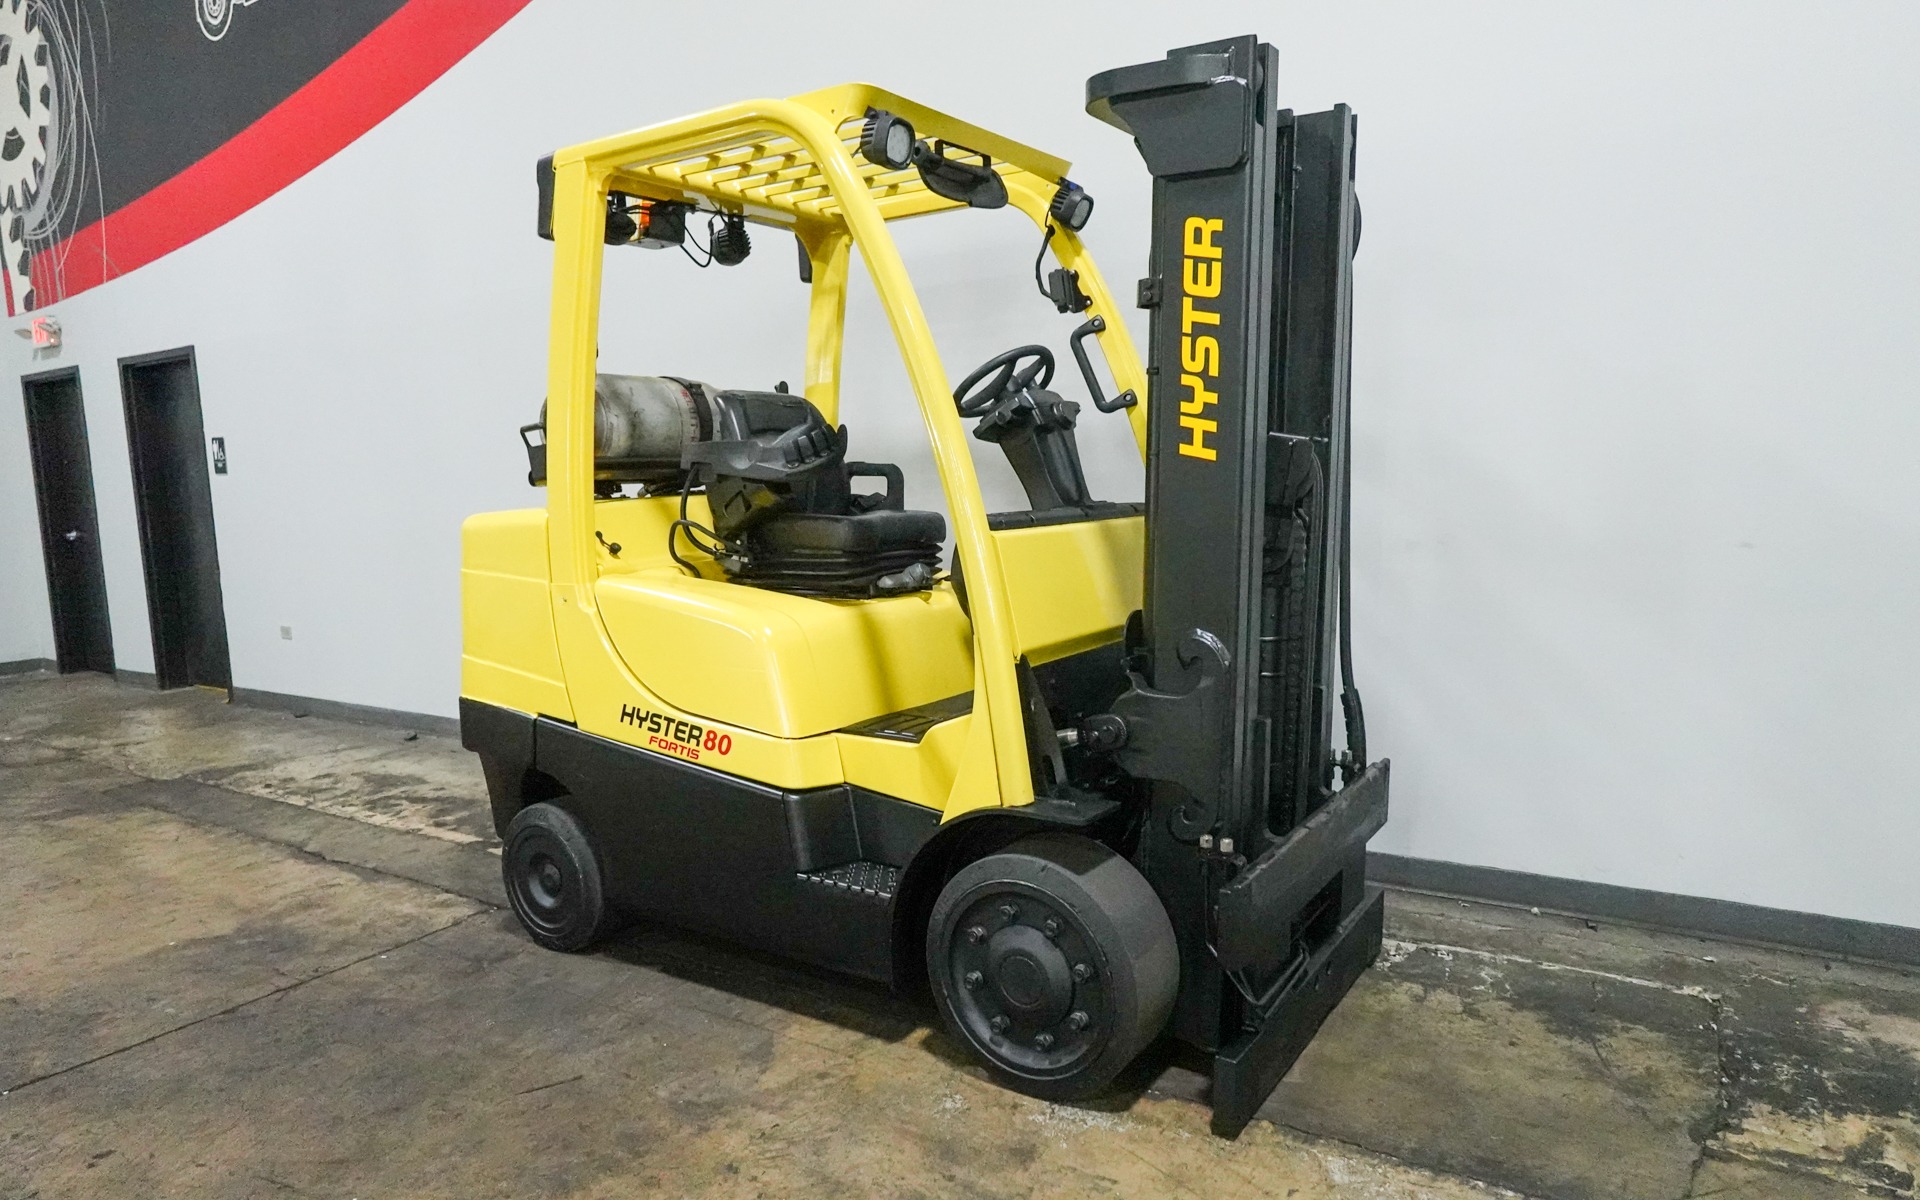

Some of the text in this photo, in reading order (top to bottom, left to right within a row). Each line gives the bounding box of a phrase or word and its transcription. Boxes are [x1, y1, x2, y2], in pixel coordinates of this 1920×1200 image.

[1179, 216, 1223, 461] HYSTER
[620, 704, 732, 755] HYSTER 80
[649, 736, 700, 760] FORTIS
